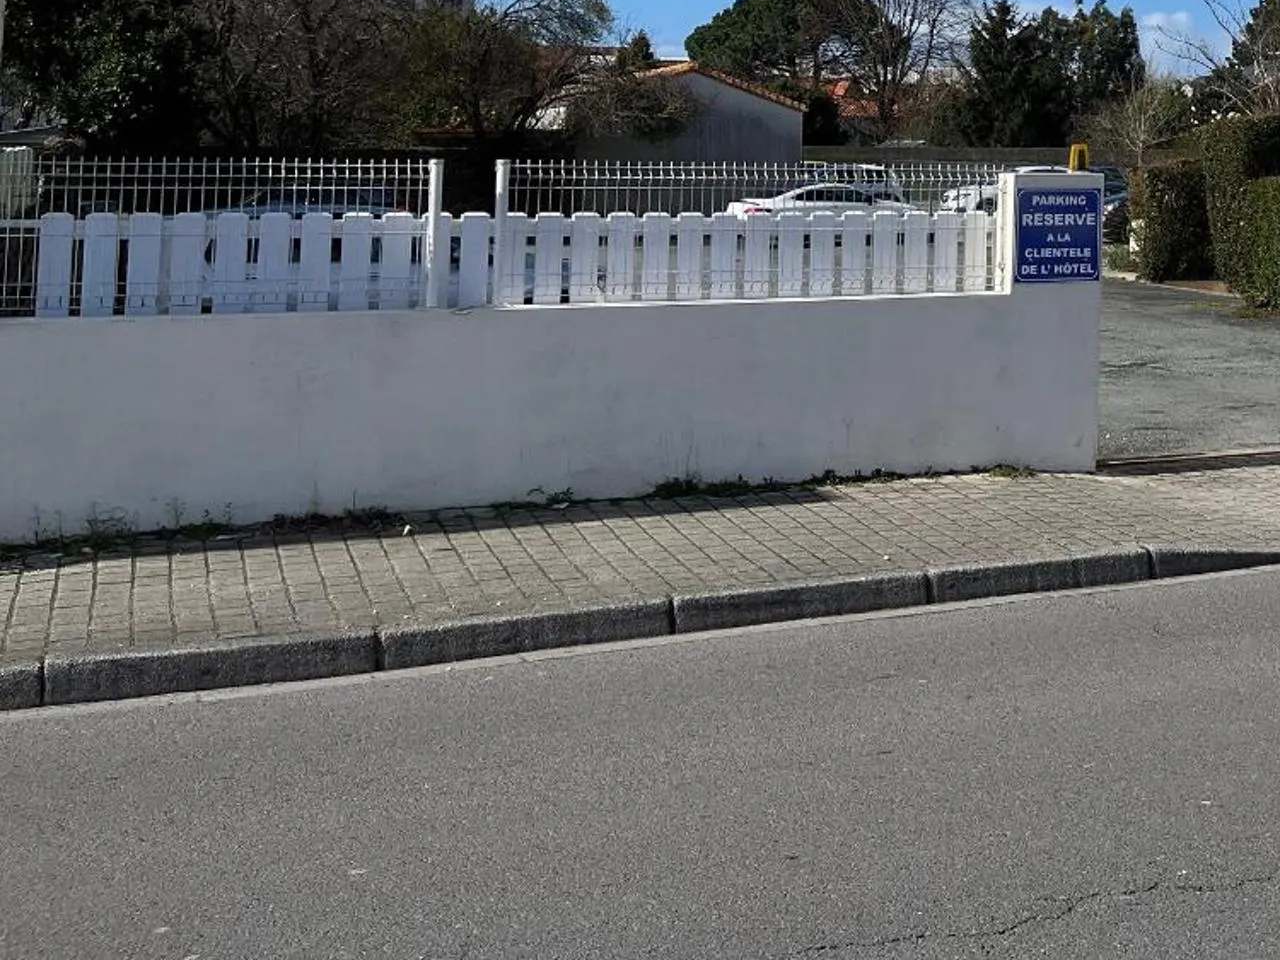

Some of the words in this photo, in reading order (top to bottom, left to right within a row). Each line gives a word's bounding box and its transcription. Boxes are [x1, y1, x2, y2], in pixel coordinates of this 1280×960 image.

[1031, 194, 1087, 206] PARKING
[1057, 232, 1071, 242] LA
[1024, 247, 1091, 258] CLIENTELE
[1021, 264, 1038, 275] DE
